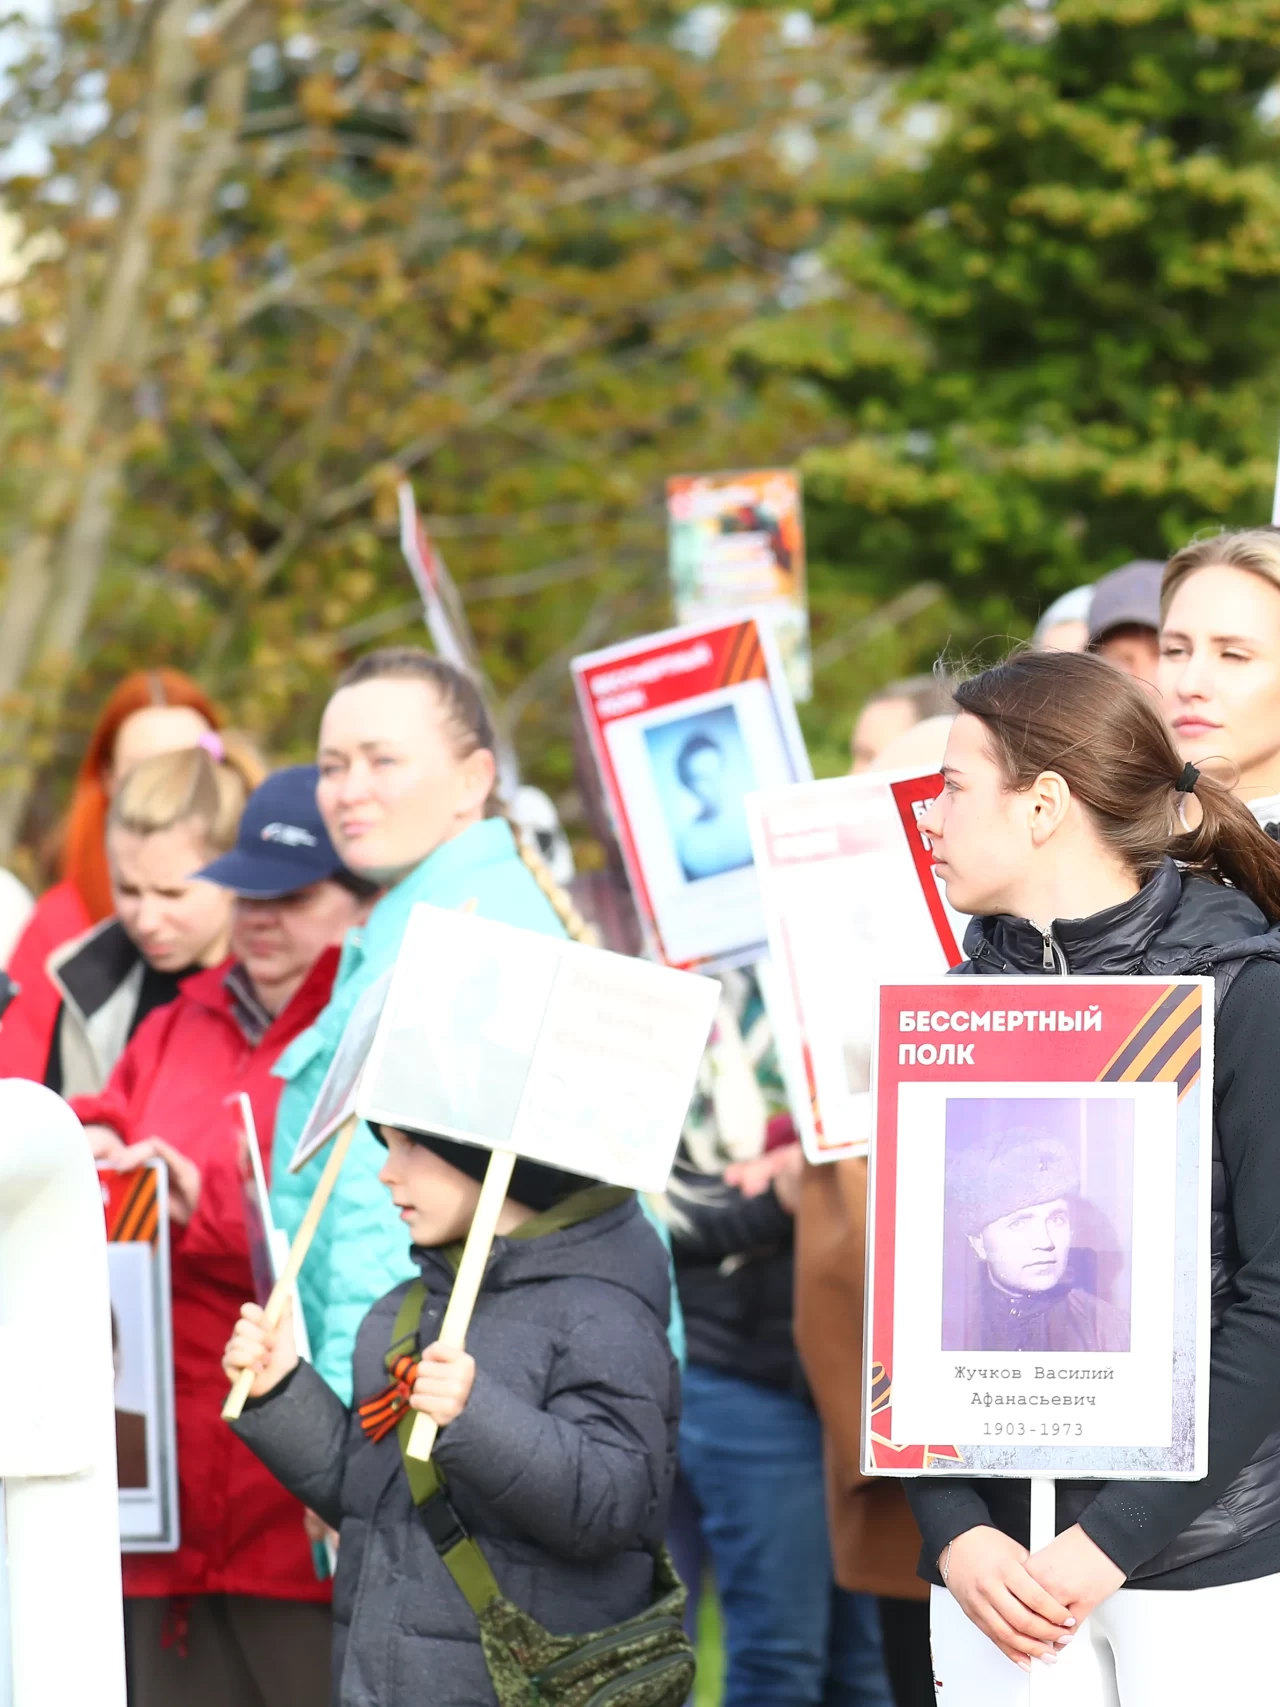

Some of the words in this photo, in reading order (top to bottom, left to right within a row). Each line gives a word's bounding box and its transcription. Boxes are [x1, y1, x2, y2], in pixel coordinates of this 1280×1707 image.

[899, 1004, 1102, 1032] БЕССМЕРТНЫЙ
[898, 1043, 975, 1065] ПОЛК
[954, 1365, 1022, 1382] Жучков
[1034, 1365, 1115, 1381] Василий
[970, 1392, 1097, 1408] Афанасьевич
[983, 1421, 1084, 1437] 1903-1973
